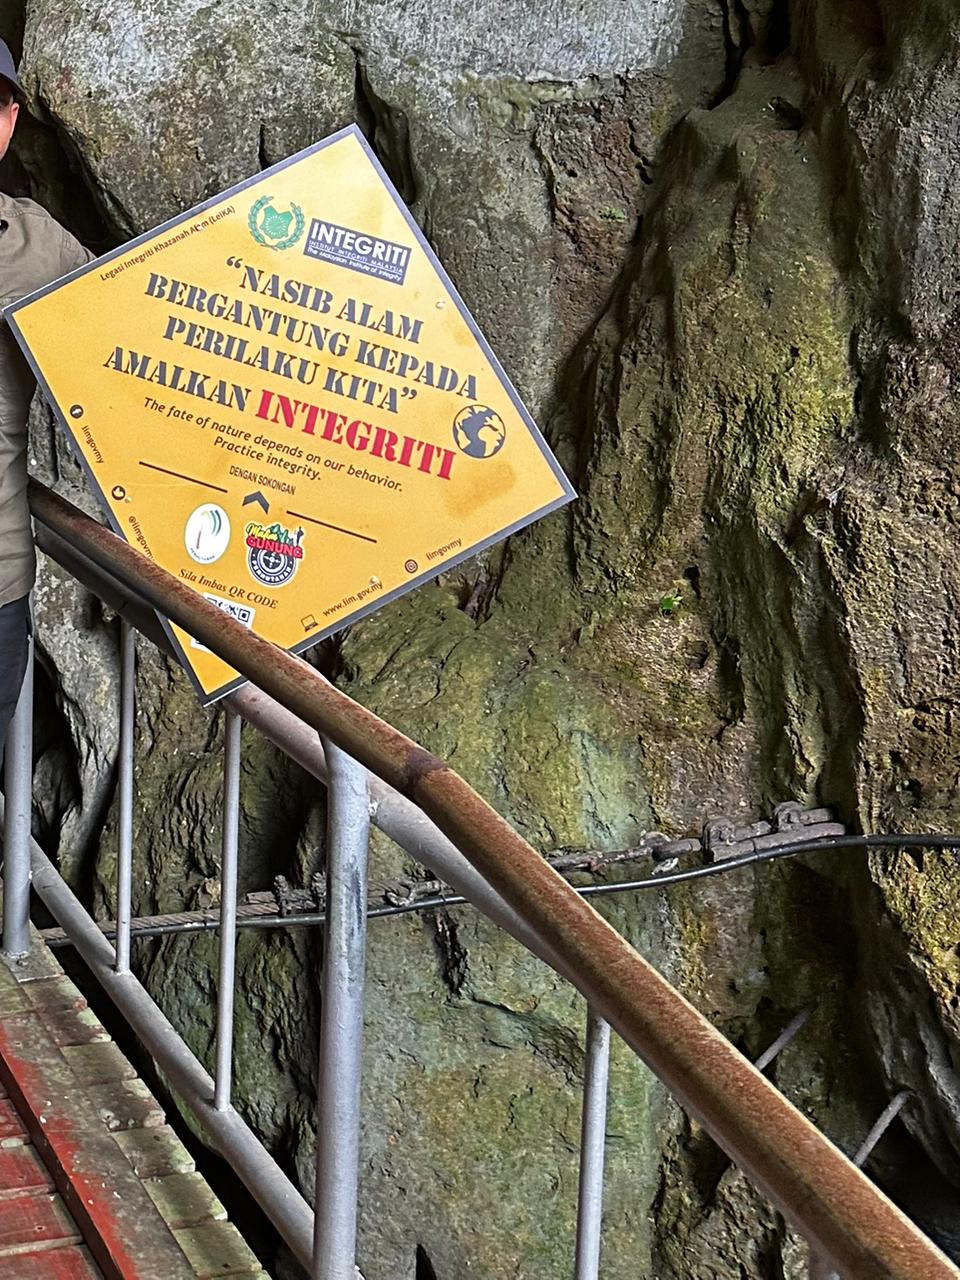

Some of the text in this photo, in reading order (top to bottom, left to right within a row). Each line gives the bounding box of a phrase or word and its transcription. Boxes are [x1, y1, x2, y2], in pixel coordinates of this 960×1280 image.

[100, 263, 125, 281] Legasi
[124, 247, 155, 268] Integriti
[154, 229, 190, 253] Khazanah
[311, 222, 408, 267] INTEGRITI
[226, 256, 424, 344] “NASIB ALAM
[144, 272, 478, 401] BERGANTUNG KEPADA
[162, 315, 418, 414] PERILAKU KITA”
[102, 346, 457, 480] AMALKAN INTEGRITI
[144, 396, 403, 492] The fate of nature depends on our behavior.
[214, 436, 321, 481] Practice integrity.
[229, 465, 297, 495] DENGAN SOKONGAN
[246, 535, 303, 559] GUNUNG
[178, 568, 279, 609] Sila Imbas QR CODE
